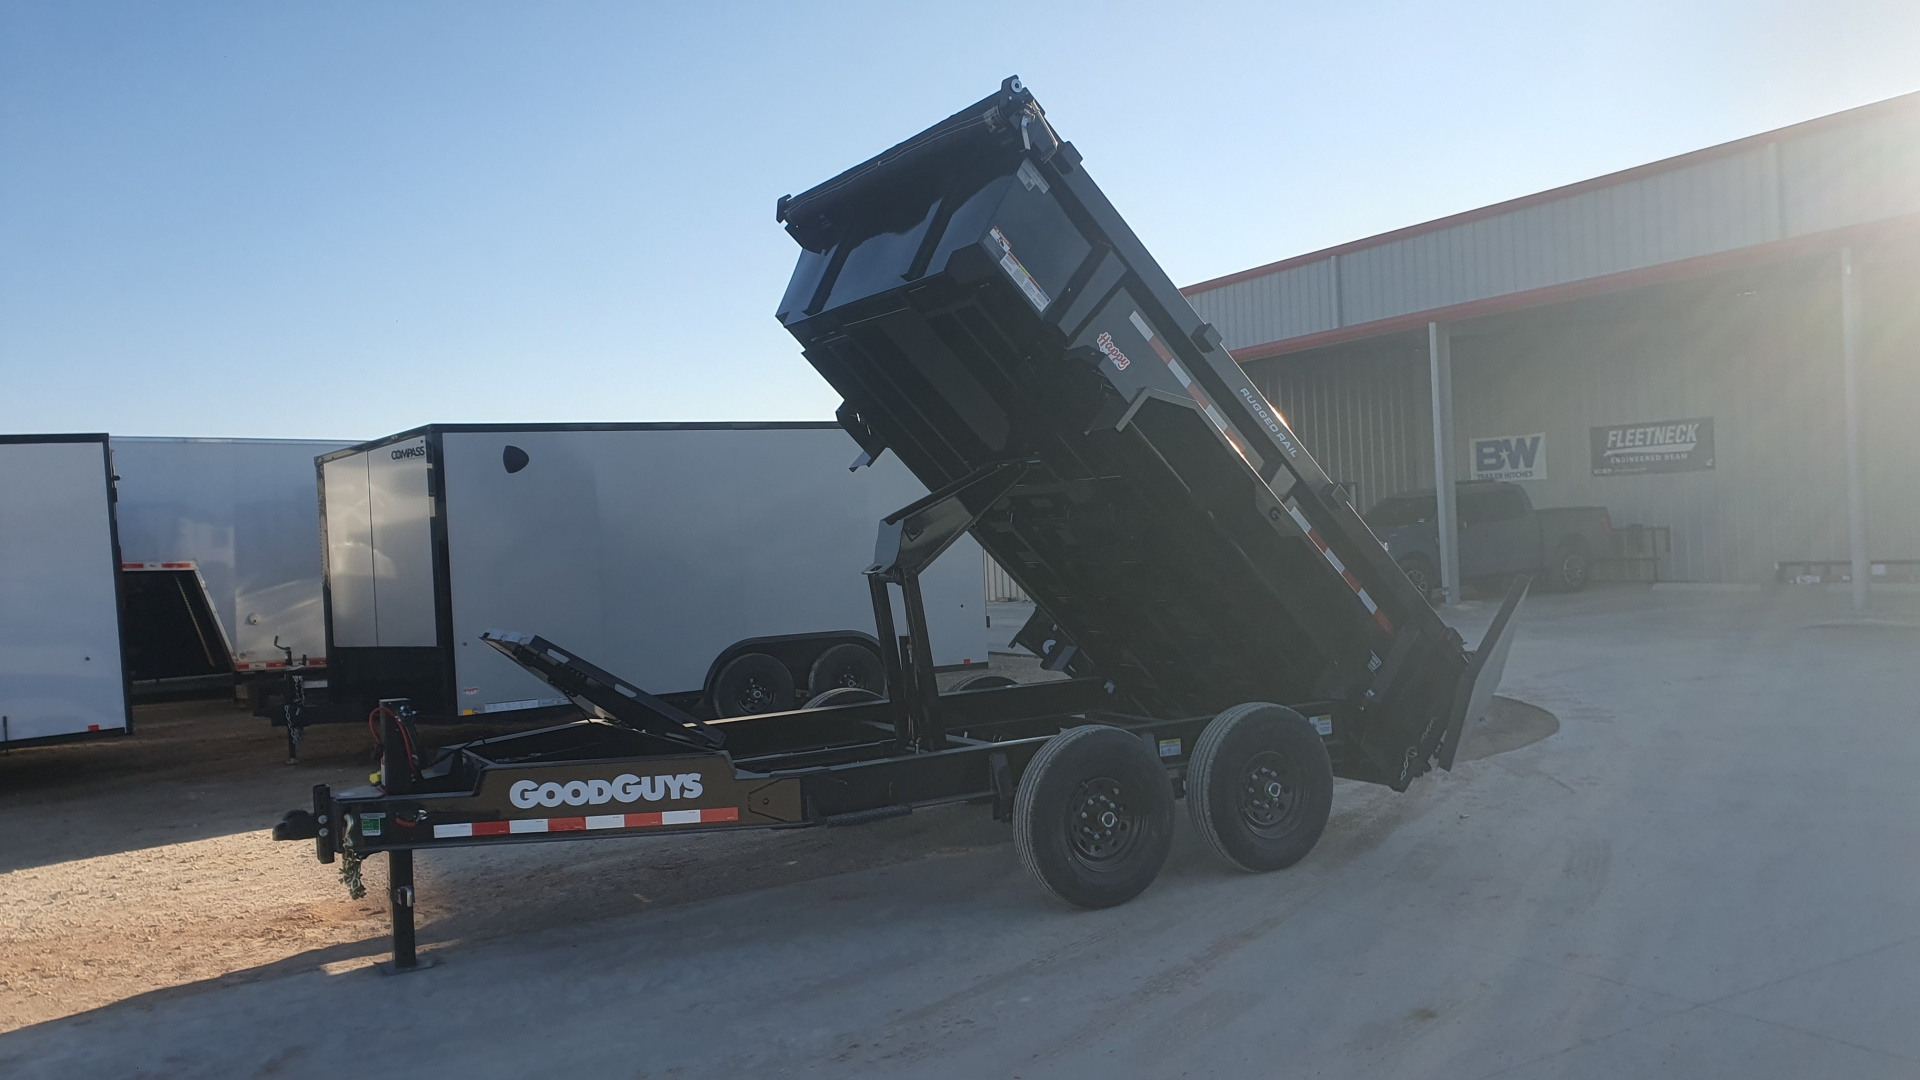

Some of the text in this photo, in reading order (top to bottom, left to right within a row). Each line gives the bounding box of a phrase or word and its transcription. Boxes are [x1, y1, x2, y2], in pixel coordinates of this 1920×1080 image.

[1097, 332, 1130, 370] Happy
[1240, 388, 1298, 458] RUGGED RAIL
[1606, 423, 1699, 448] FLEETNECK
[391, 446, 425, 460] COMPASS
[1610, 453, 1688, 464] ENGINEERED BEAM
[1504, 471, 1533, 479] HITCHES
[509, 773, 704, 809] GOODGUYS
